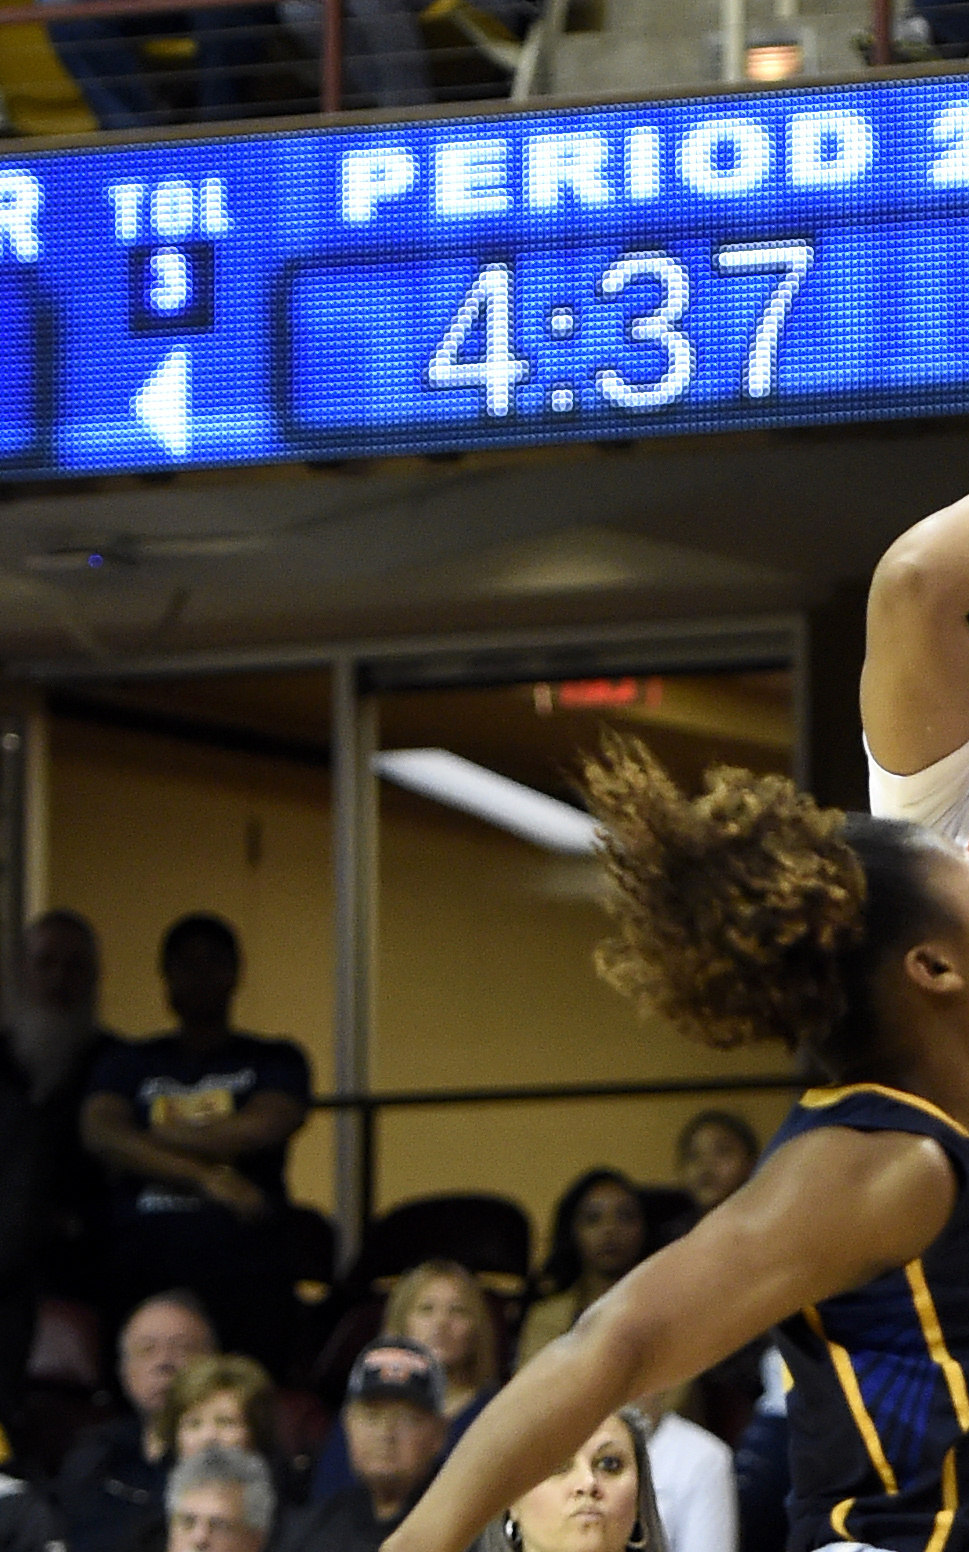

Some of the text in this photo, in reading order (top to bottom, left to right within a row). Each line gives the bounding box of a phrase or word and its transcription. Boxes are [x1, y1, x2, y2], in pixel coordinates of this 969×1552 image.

[340, 107, 876, 225] PERIOD
[145, 246, 192, 316] 3
[428, 238, 814, 417] 4:37
